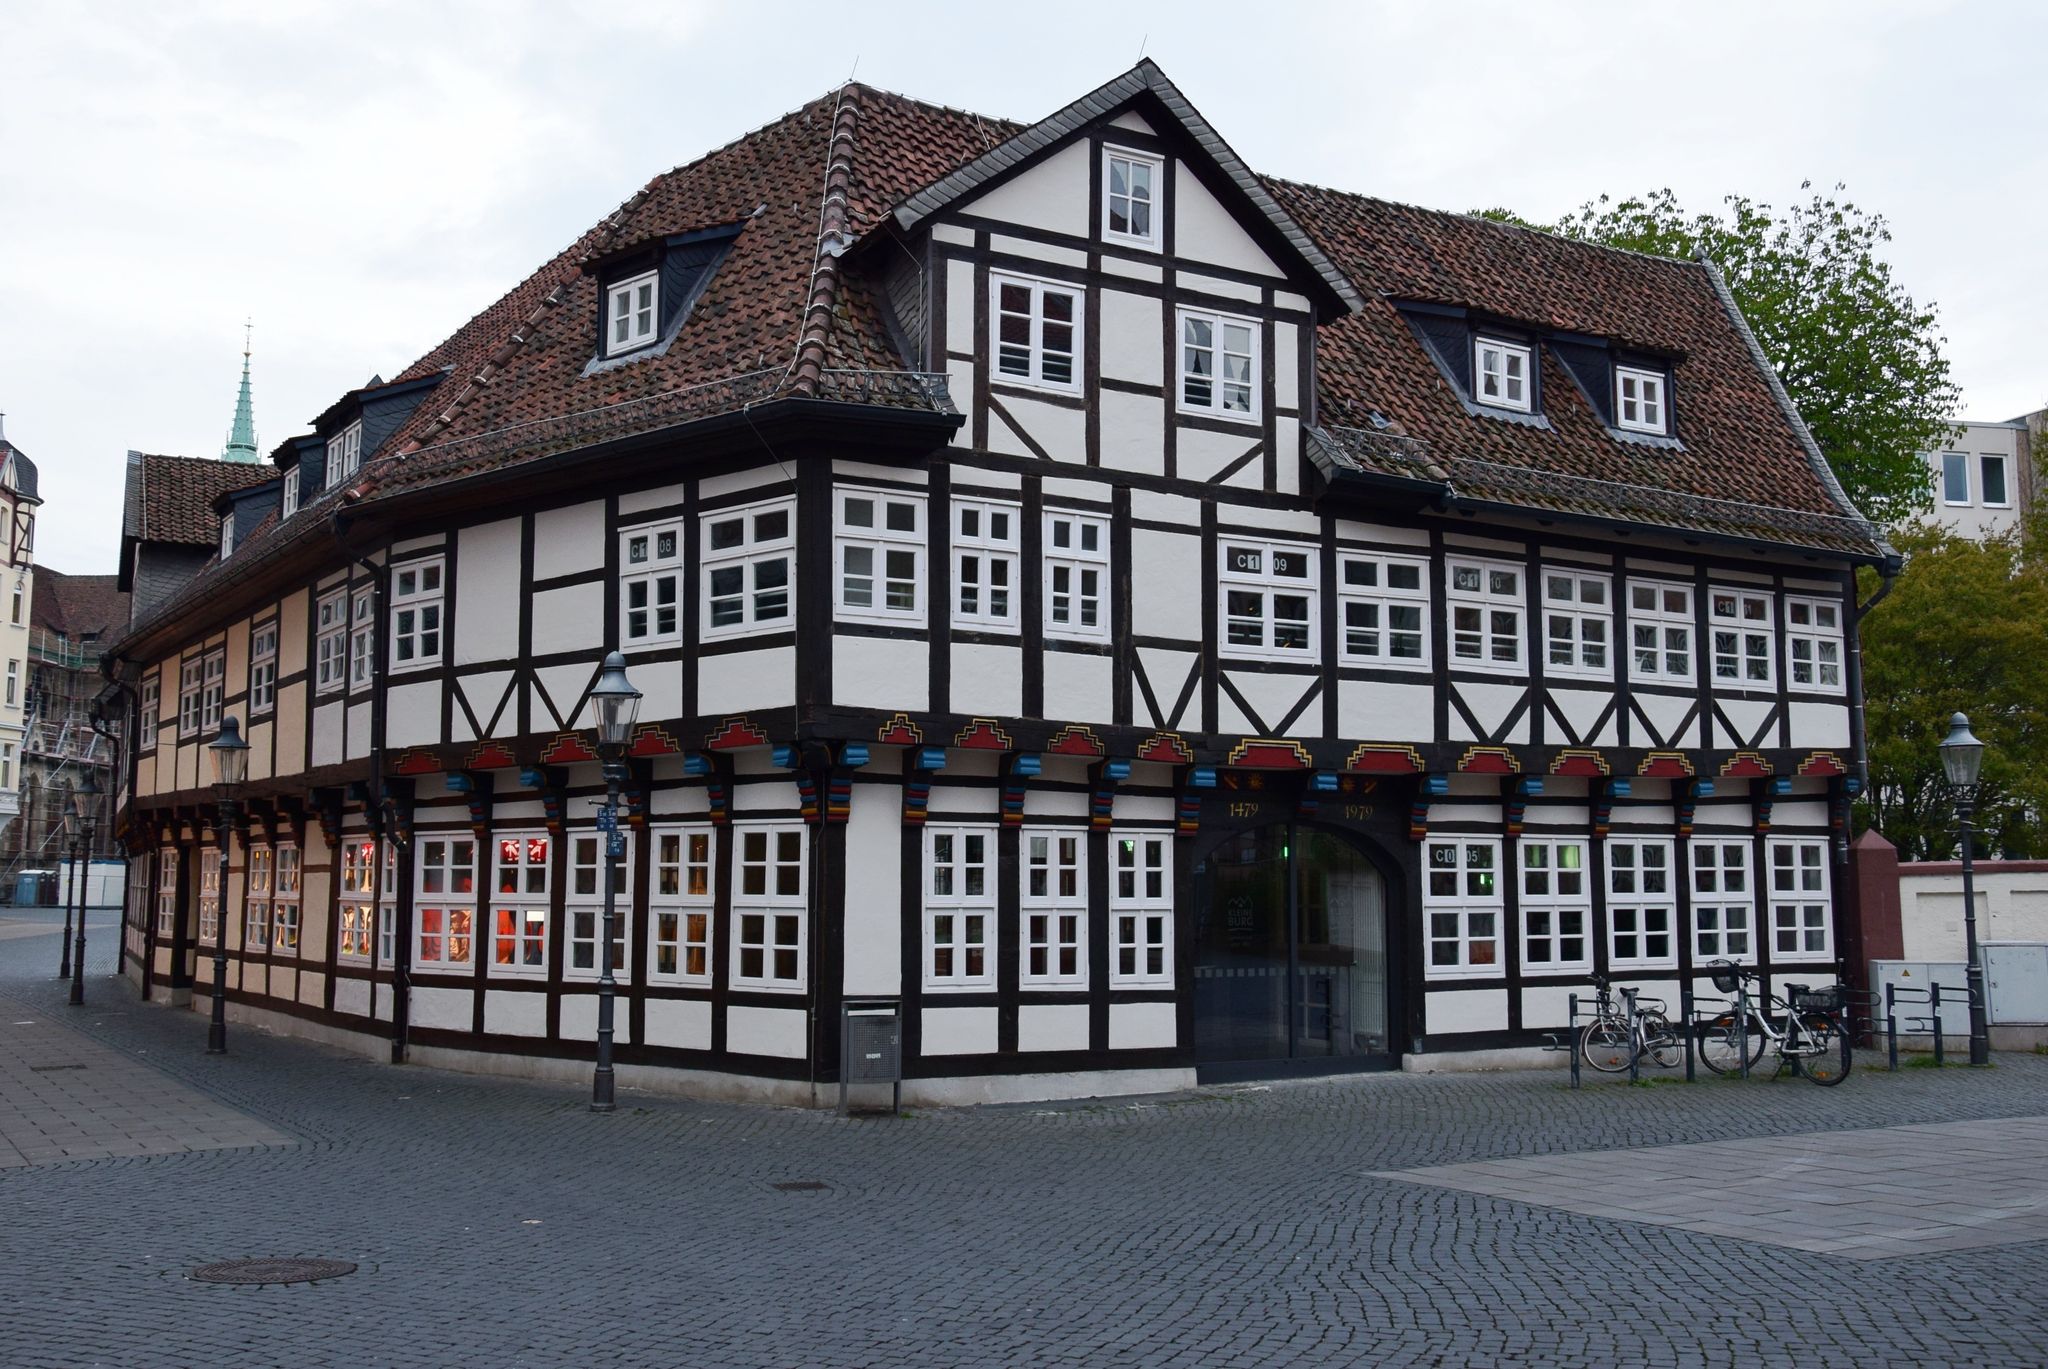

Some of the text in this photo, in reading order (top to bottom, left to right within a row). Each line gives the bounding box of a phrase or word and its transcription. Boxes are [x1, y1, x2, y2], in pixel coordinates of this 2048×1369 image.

[660, 539, 671, 553] 08
[1237, 554, 1287, 571] C1 09
[1229, 802, 1259, 818] 1479
[1344, 804, 1374, 820] 1979
[1228, 916, 1254, 928] BURG
